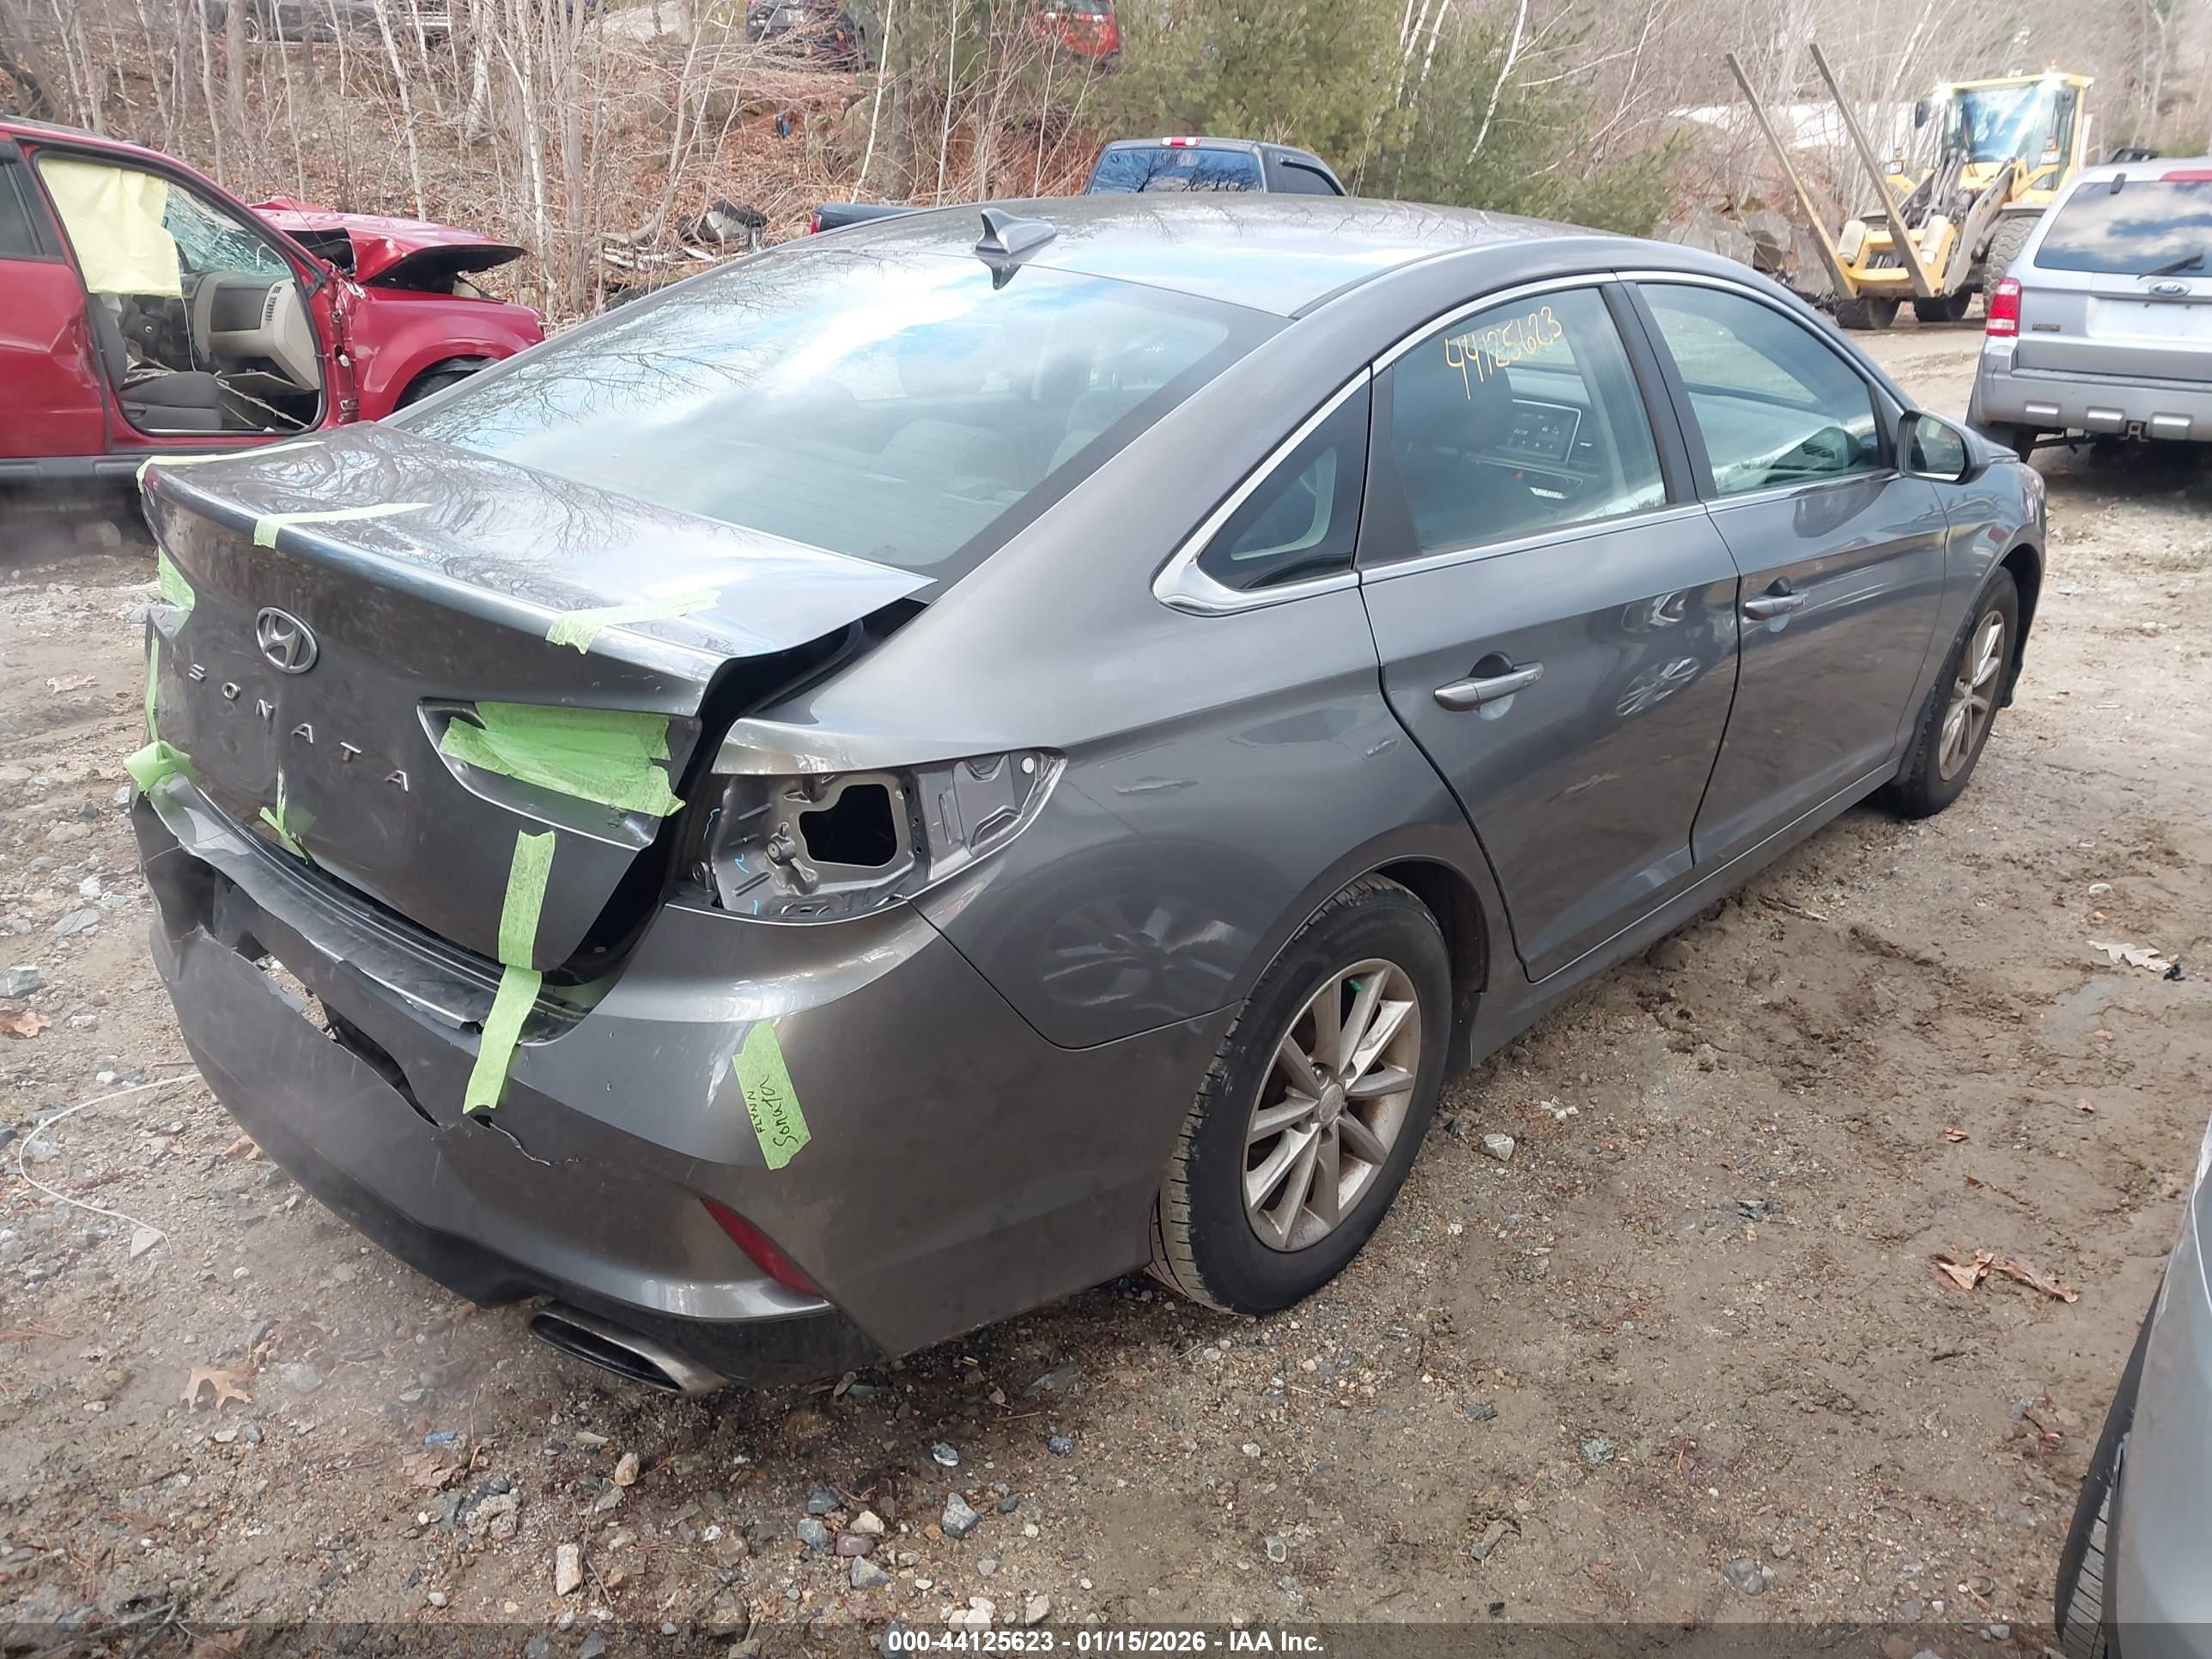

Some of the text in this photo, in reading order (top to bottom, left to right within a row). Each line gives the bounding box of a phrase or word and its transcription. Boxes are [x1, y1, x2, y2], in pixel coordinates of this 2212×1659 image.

[1445, 306, 1562, 400] 44125623
[188, 664, 409, 792] SONATA
[747, 1091, 766, 1133] FLYNN
